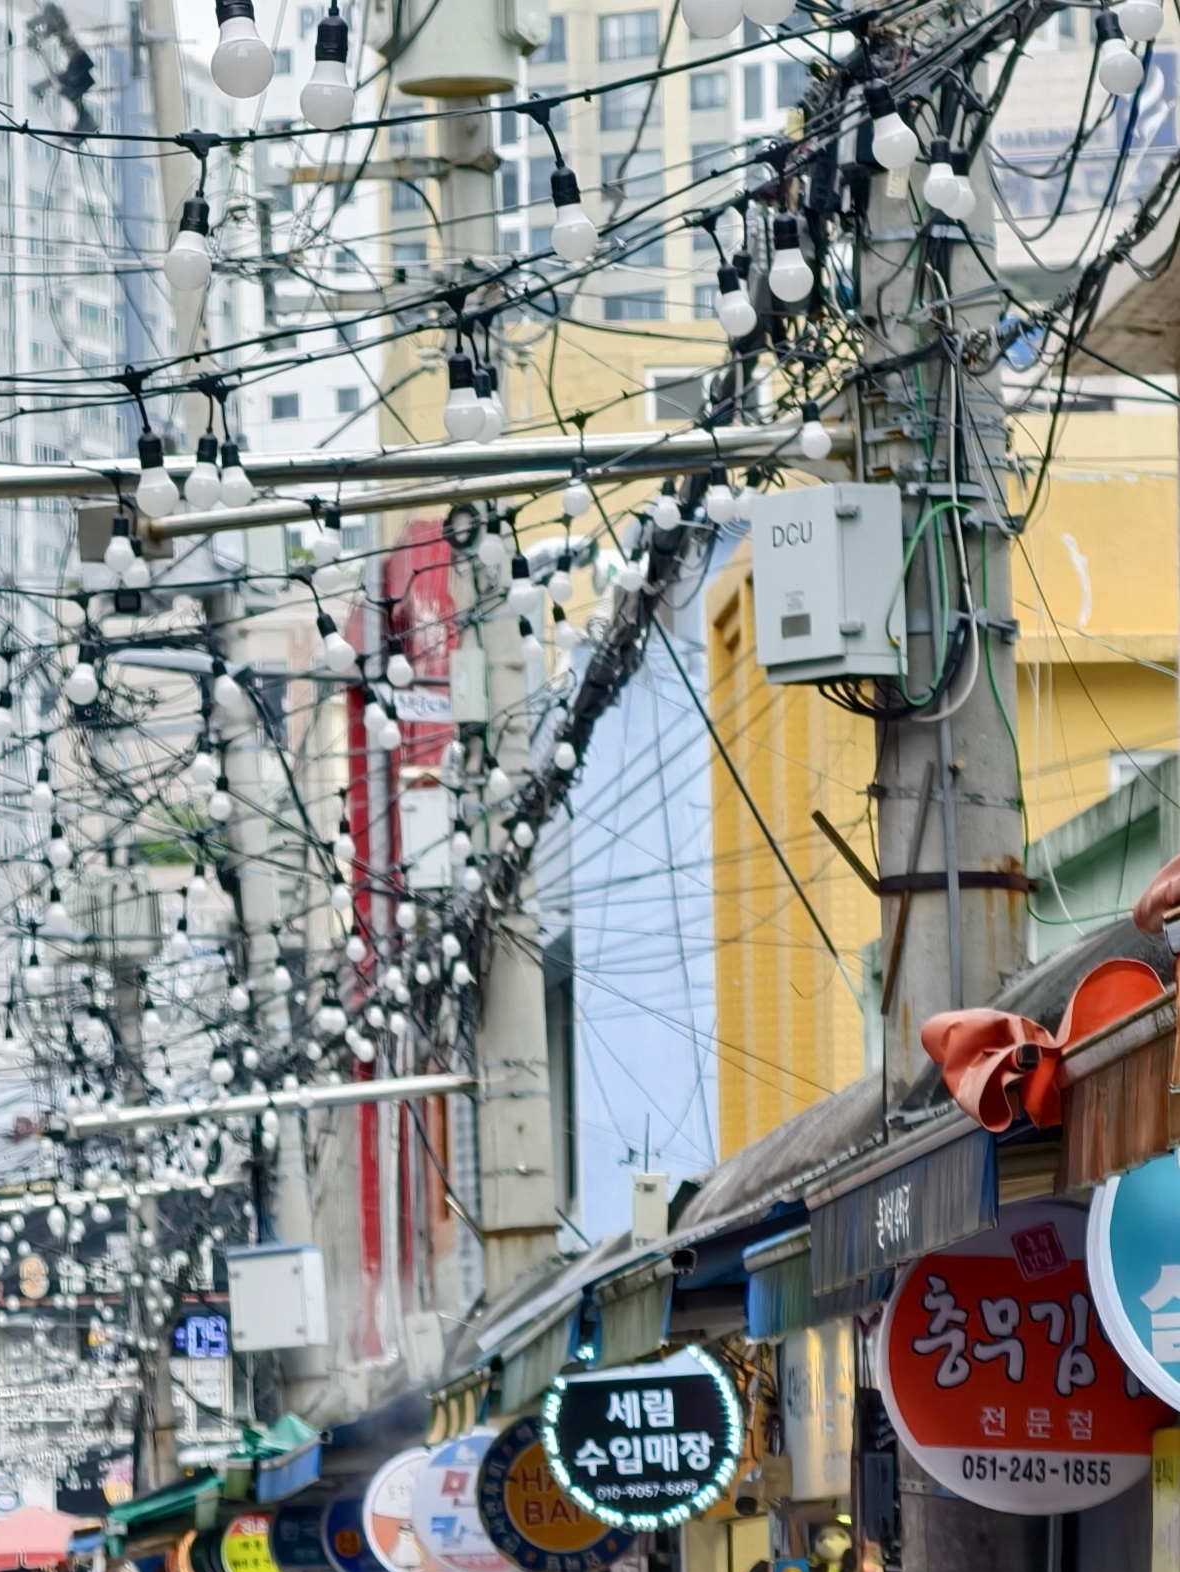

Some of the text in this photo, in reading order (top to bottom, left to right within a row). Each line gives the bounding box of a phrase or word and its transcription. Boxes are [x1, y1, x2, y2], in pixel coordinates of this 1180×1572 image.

[772, 521, 813, 548] DCU
[911, 1276, 1151, 1399] 충무김
[606, 1388, 675, 1429] 세림
[980, 1406, 1094, 1441] 전문점
[573, 1431, 715, 1477] 수입매장
[962, 1455, 1112, 1488] 051-243-1855
